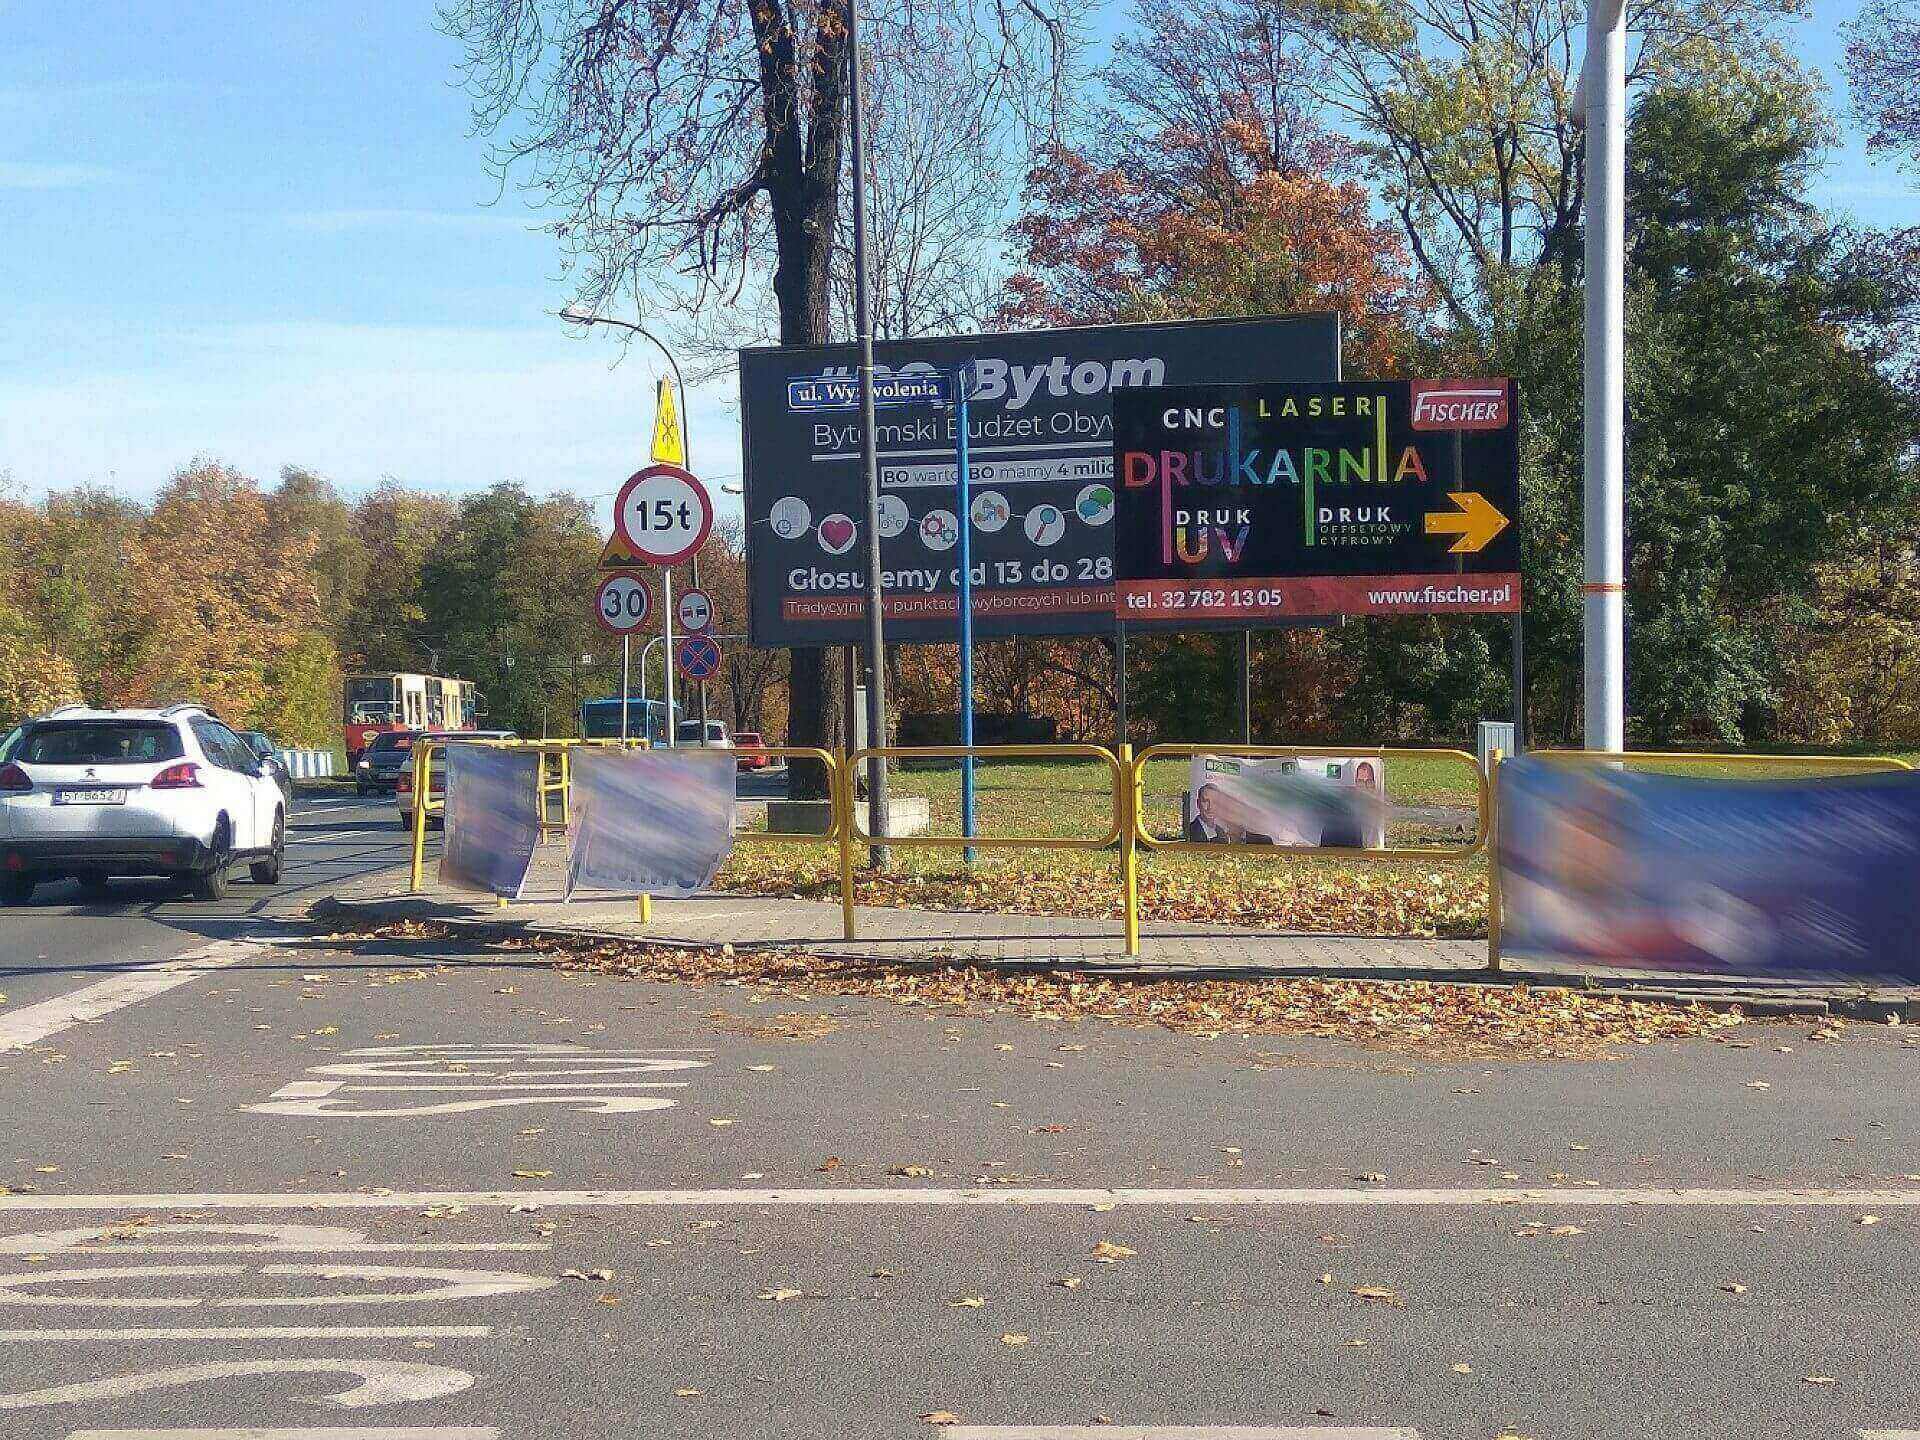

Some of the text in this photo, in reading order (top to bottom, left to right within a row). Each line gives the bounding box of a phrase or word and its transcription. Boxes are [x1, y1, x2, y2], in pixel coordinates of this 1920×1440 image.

[798, 380, 939, 404] ul. Wywolenia
[974, 357, 1165, 409] Bytom
[1163, 396, 1372, 429] CNC LASER
[1414, 390, 1502, 422] FISCHER
[814, 417, 937, 449] Bytmski
[884, 470, 909, 483] BO
[968, 466, 994, 479] BO
[1056, 464, 1068, 477] 4
[636, 501, 691, 531] 15t
[1176, 510, 1250, 525] DRUK
[1319, 507, 1391, 523] DRUK
[1176, 526, 1250, 564] UV
[1319, 535, 1395, 546] CYFROWY
[788, 566, 942, 592] Głosuemy
[995, 561, 1022, 584] 13
[1031, 559, 1070, 582] do
[1077, 556, 1113, 580] 28
[604, 588, 645, 618] 30
[787, 601, 865, 616] Tradycyjni
[894, 597, 960, 614] punktac
[1067, 591, 1091, 605] lub
[1127, 589, 1282, 609] tel. 32 782 13 05
[1368, 584, 1511, 606] www.fischer.pl
